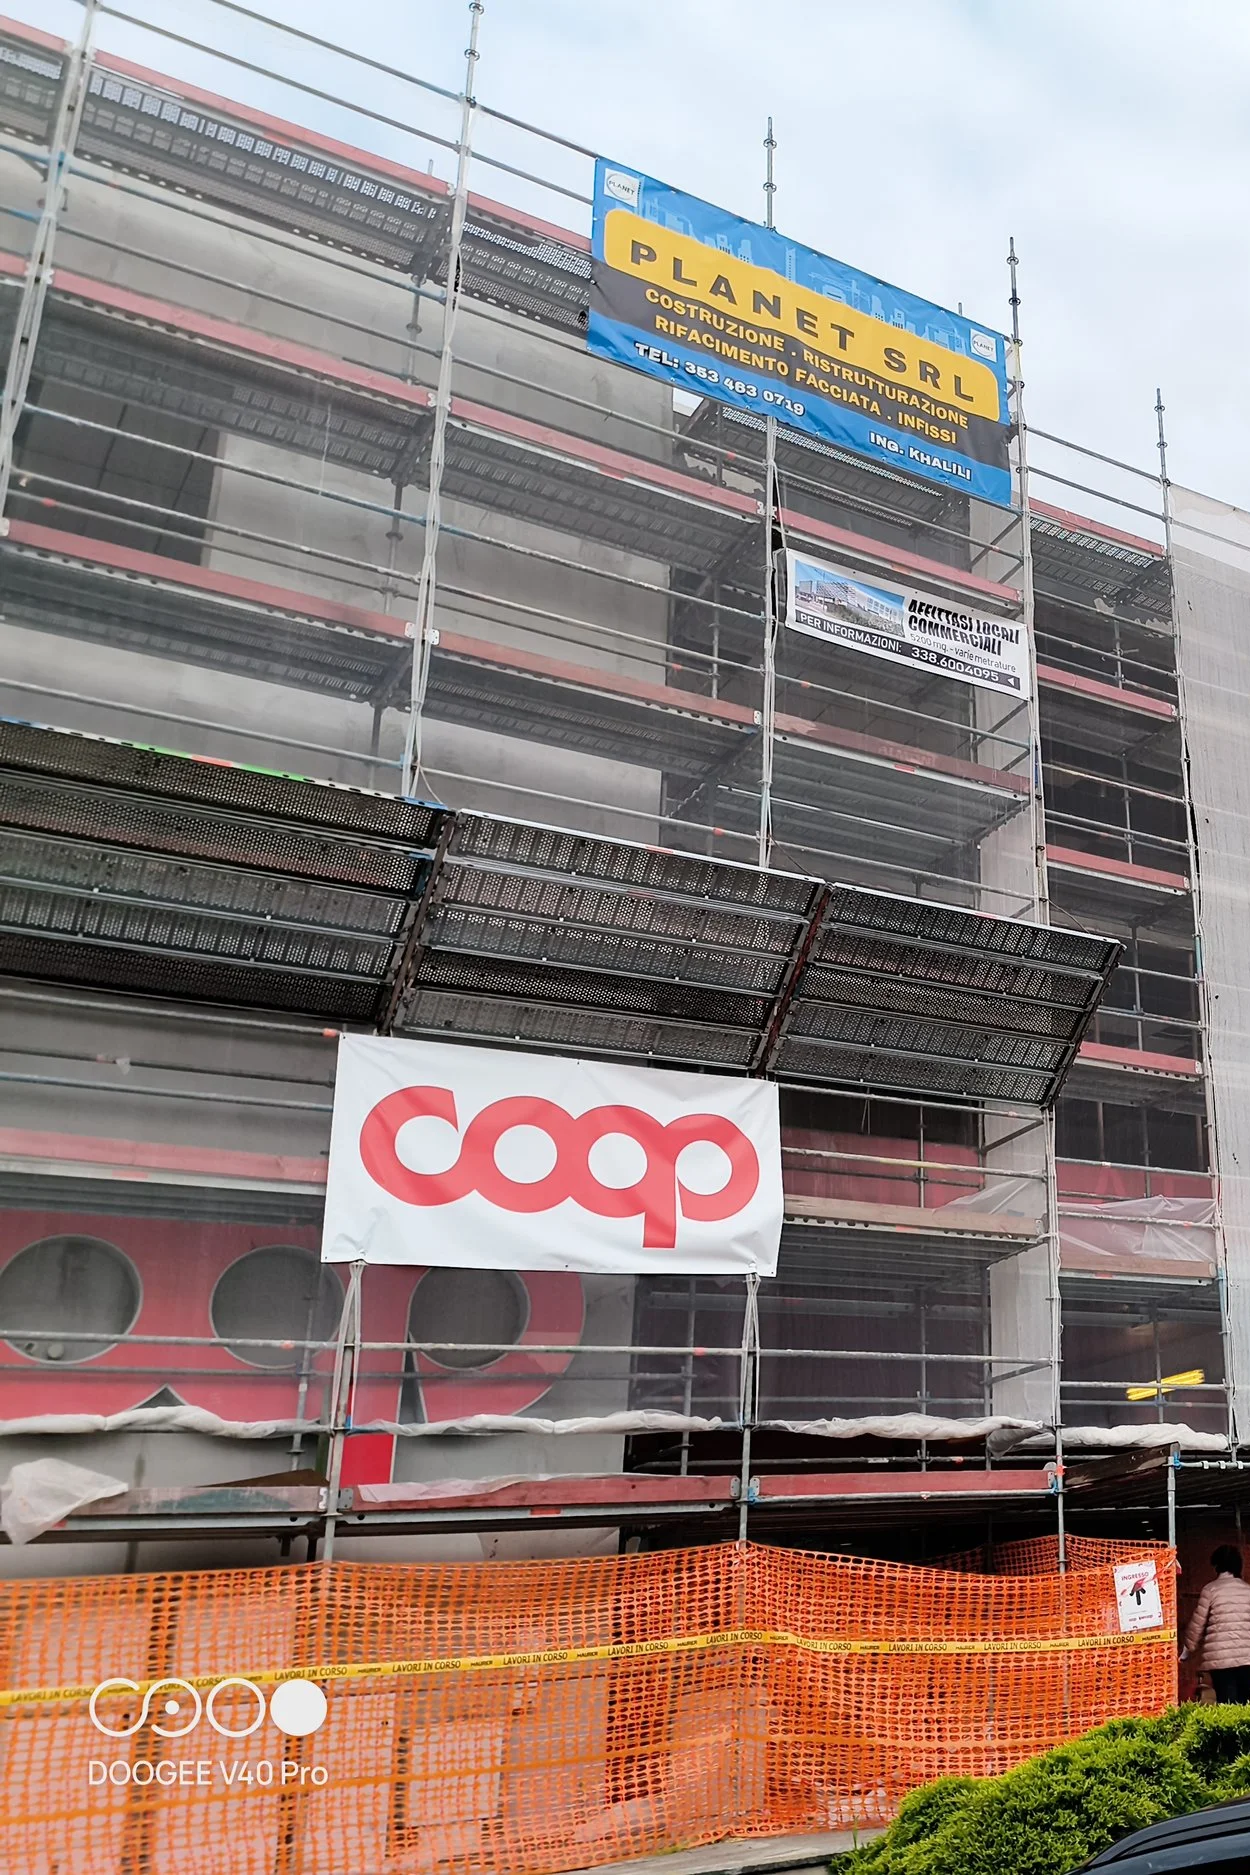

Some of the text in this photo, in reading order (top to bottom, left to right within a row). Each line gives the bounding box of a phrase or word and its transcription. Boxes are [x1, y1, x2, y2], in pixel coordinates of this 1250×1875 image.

[631, 240, 974, 402] PLANET SRL
[645, 288, 785, 352] COSTRUZIONE
[803, 349, 968, 429] RISTRUTTURAZIONE
[635, 342, 805, 416] TEL: 353 463 0719
[655, 315, 789, 376] RIFACIMENTO
[796, 368, 882, 416] FACCIATA
[898, 412, 956, 444] INFISSI
[869, 432, 971, 481] ING. KHALILI
[800, 613, 902, 653] PER INFORMAZIONI:
[908, 599, 1019, 644] AFFITTASI LOCALI
[908, 615, 1001, 656] COMMERCIALI
[910, 633, 932, 646] 5200
[954, 647, 974, 661] varie
[975, 656, 1016, 673] metrature
[911, 647, 999, 682] 338.6004095
[359, 1085, 759, 1249] coop
[607, 1642, 668, 1656] LAVORI IN CORSO
[706, 1632, 763, 1644] LAVORI IN CORSO
[796, 1638, 852, 1651] LAVORI IN CORSO
[924, 1643, 947, 1651] CORSO
[1078, 1638, 1101, 1647] LAVORI
[1113, 1636, 1134, 1644] CORSO
[274, 1670, 305, 1680] LAVORI
[319, 1666, 347, 1676] CORSO
[392, 1660, 461, 1673] LAVORI IN CORSO
[503, 1655, 530, 1665] LAVORI
[543, 1652, 568, 1661] CORSO
